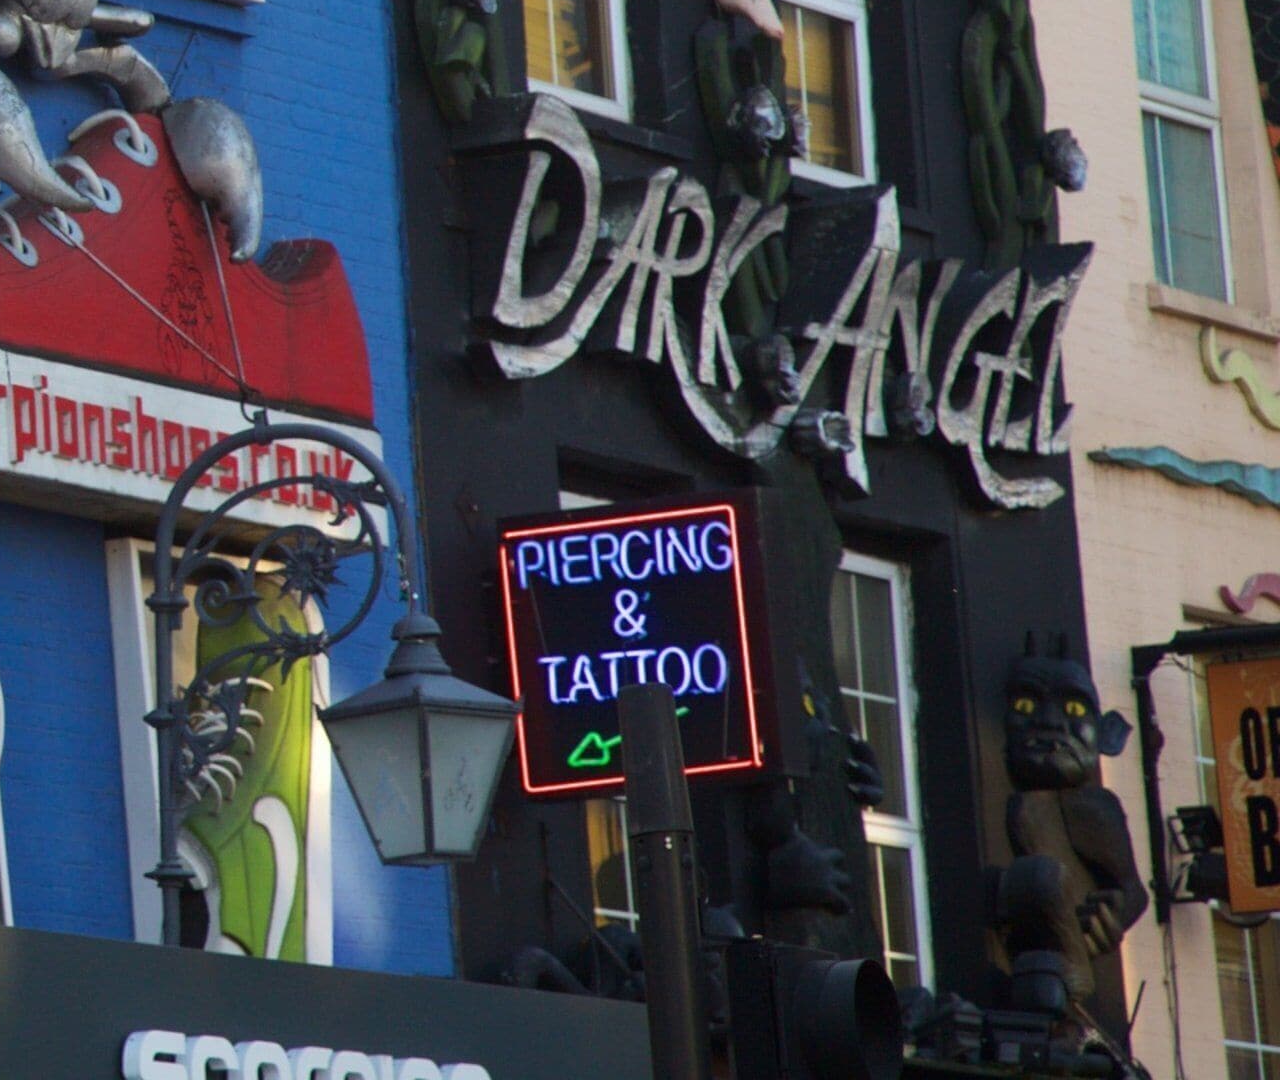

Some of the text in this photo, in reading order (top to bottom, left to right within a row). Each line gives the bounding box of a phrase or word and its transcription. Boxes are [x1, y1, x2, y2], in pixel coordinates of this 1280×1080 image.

[490, 93, 1096, 510] DARK ANGEL
[517, 520, 733, 589] PIERCING
[613, 588, 647, 638] &
[538, 643, 728, 704] TATTOO
